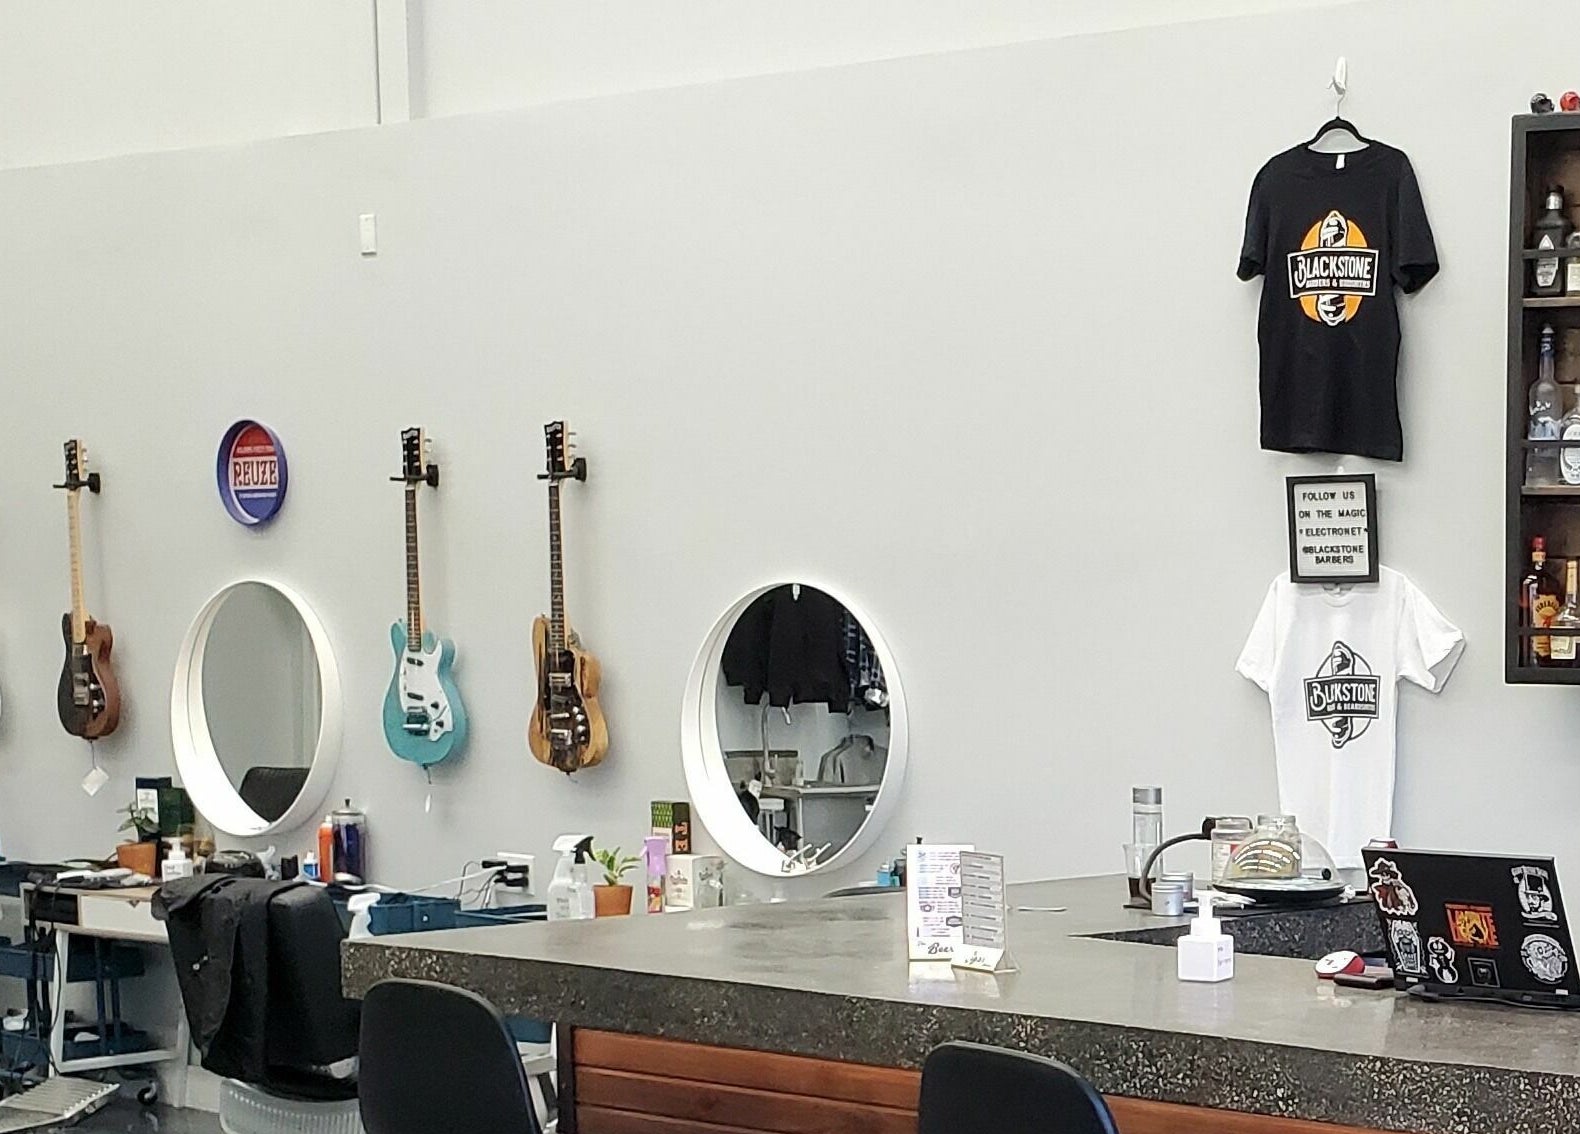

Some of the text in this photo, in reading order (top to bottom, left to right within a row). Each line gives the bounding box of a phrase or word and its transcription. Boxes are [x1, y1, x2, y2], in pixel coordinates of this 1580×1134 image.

[1294, 255, 1373, 288] BLACKSTONE
[233, 460, 277, 487] REUZE
[1302, 491, 1355, 501] FOLLOW US
[1298, 509, 1366, 519] ON THE MAGIC
[1302, 545, 1364, 554] @BLACKSTONE
[1315, 555, 1354, 564] BARBERS
